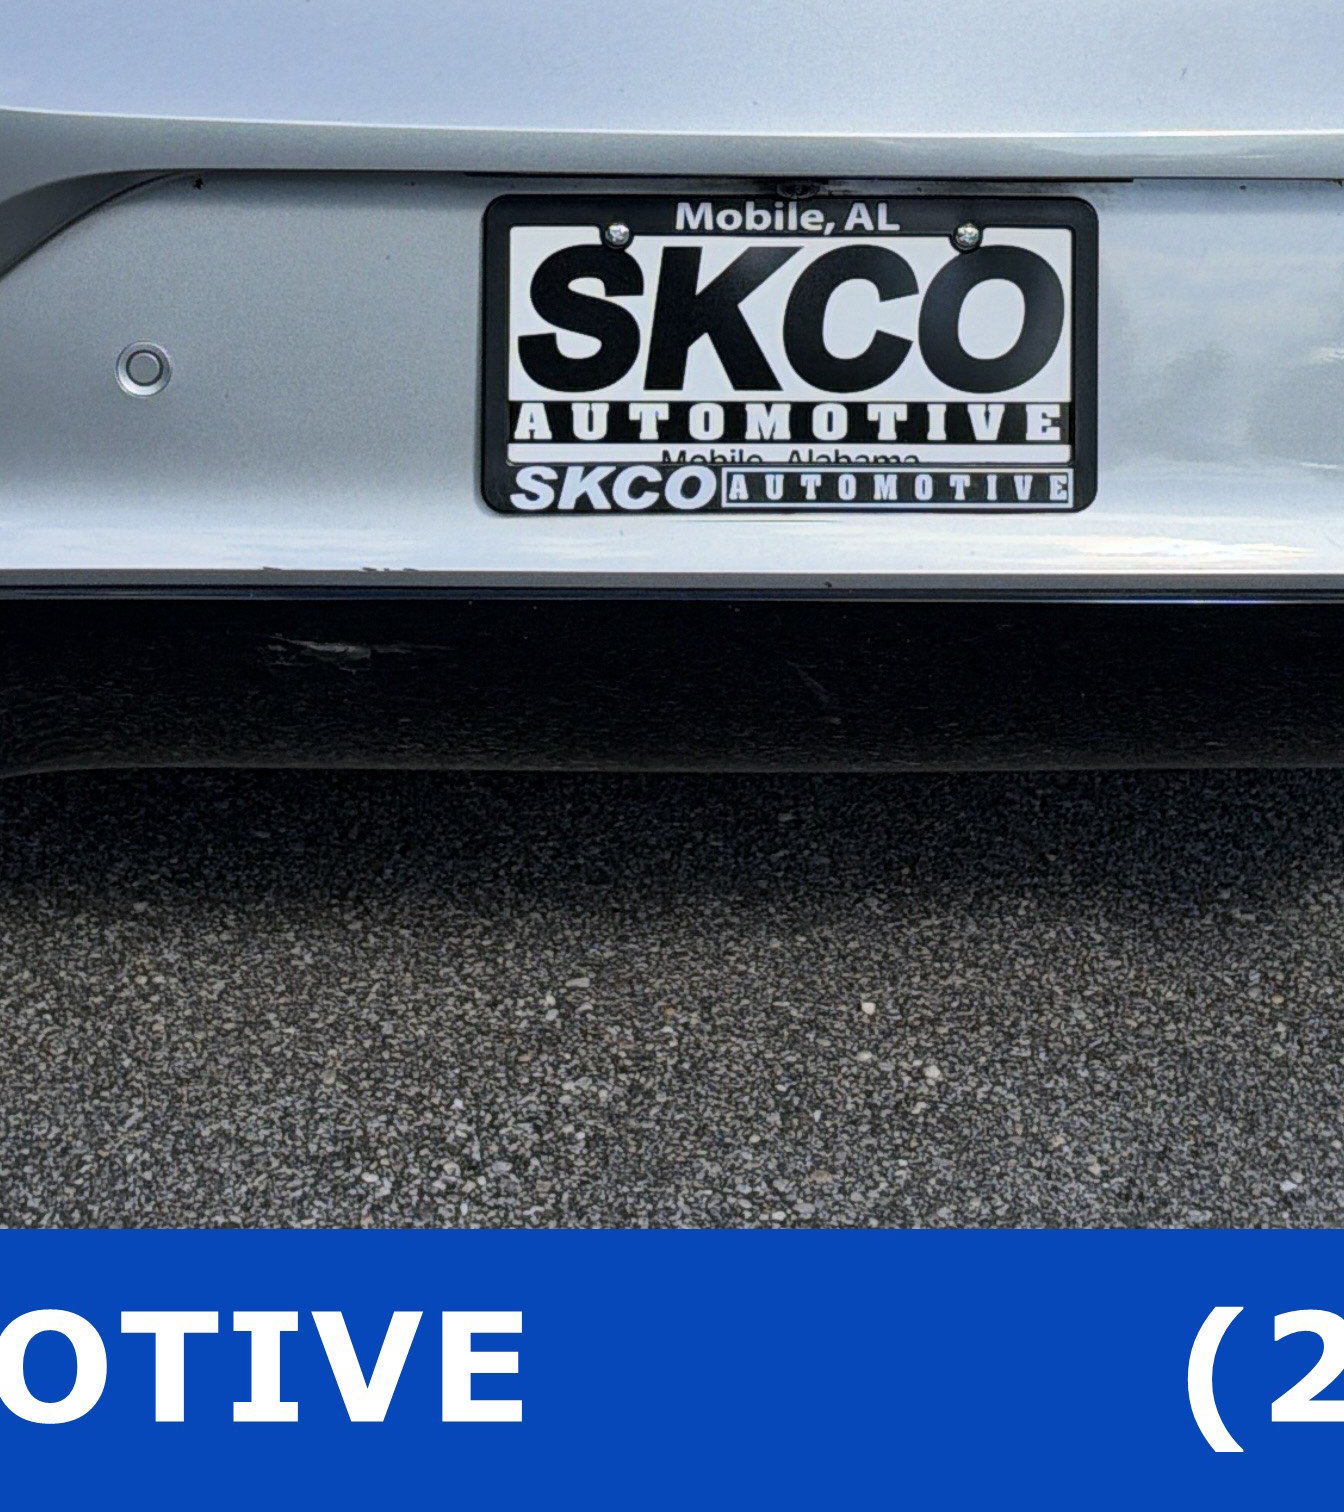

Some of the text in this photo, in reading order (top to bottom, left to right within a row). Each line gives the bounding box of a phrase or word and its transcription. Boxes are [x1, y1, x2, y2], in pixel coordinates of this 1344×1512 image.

[675, 201, 901, 236] Mobile, AL
[517, 243, 1066, 394] SKCO
[513, 402, 1062, 441] AUTOMOTIVE
[509, 464, 1070, 511] SKCO AUTOMOTIVE
